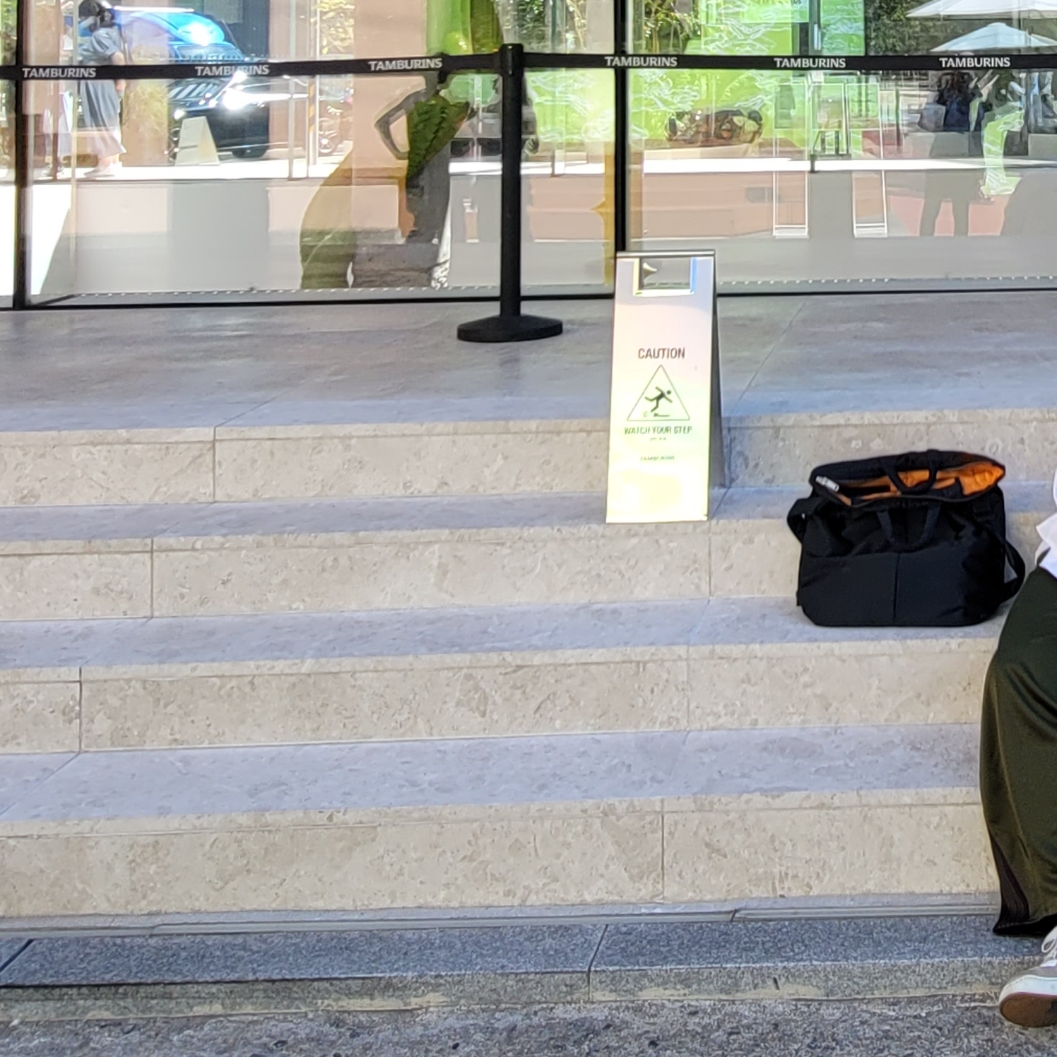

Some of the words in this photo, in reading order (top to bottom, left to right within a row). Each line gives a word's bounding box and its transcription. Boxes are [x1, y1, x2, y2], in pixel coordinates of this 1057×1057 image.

[367, 58, 443, 71] TAMBURINS
[604, 56, 678, 68] TAMBURINS
[773, 57, 847, 69] TAMBURINS
[939, 56, 1011, 69] TAMBURINS
[22, 67, 97, 78] TAMBURINS
[195, 65, 270, 76] TAMBURINS
[637, 346, 686, 360] CAUTION
[652, 425, 672, 435] YOUR
